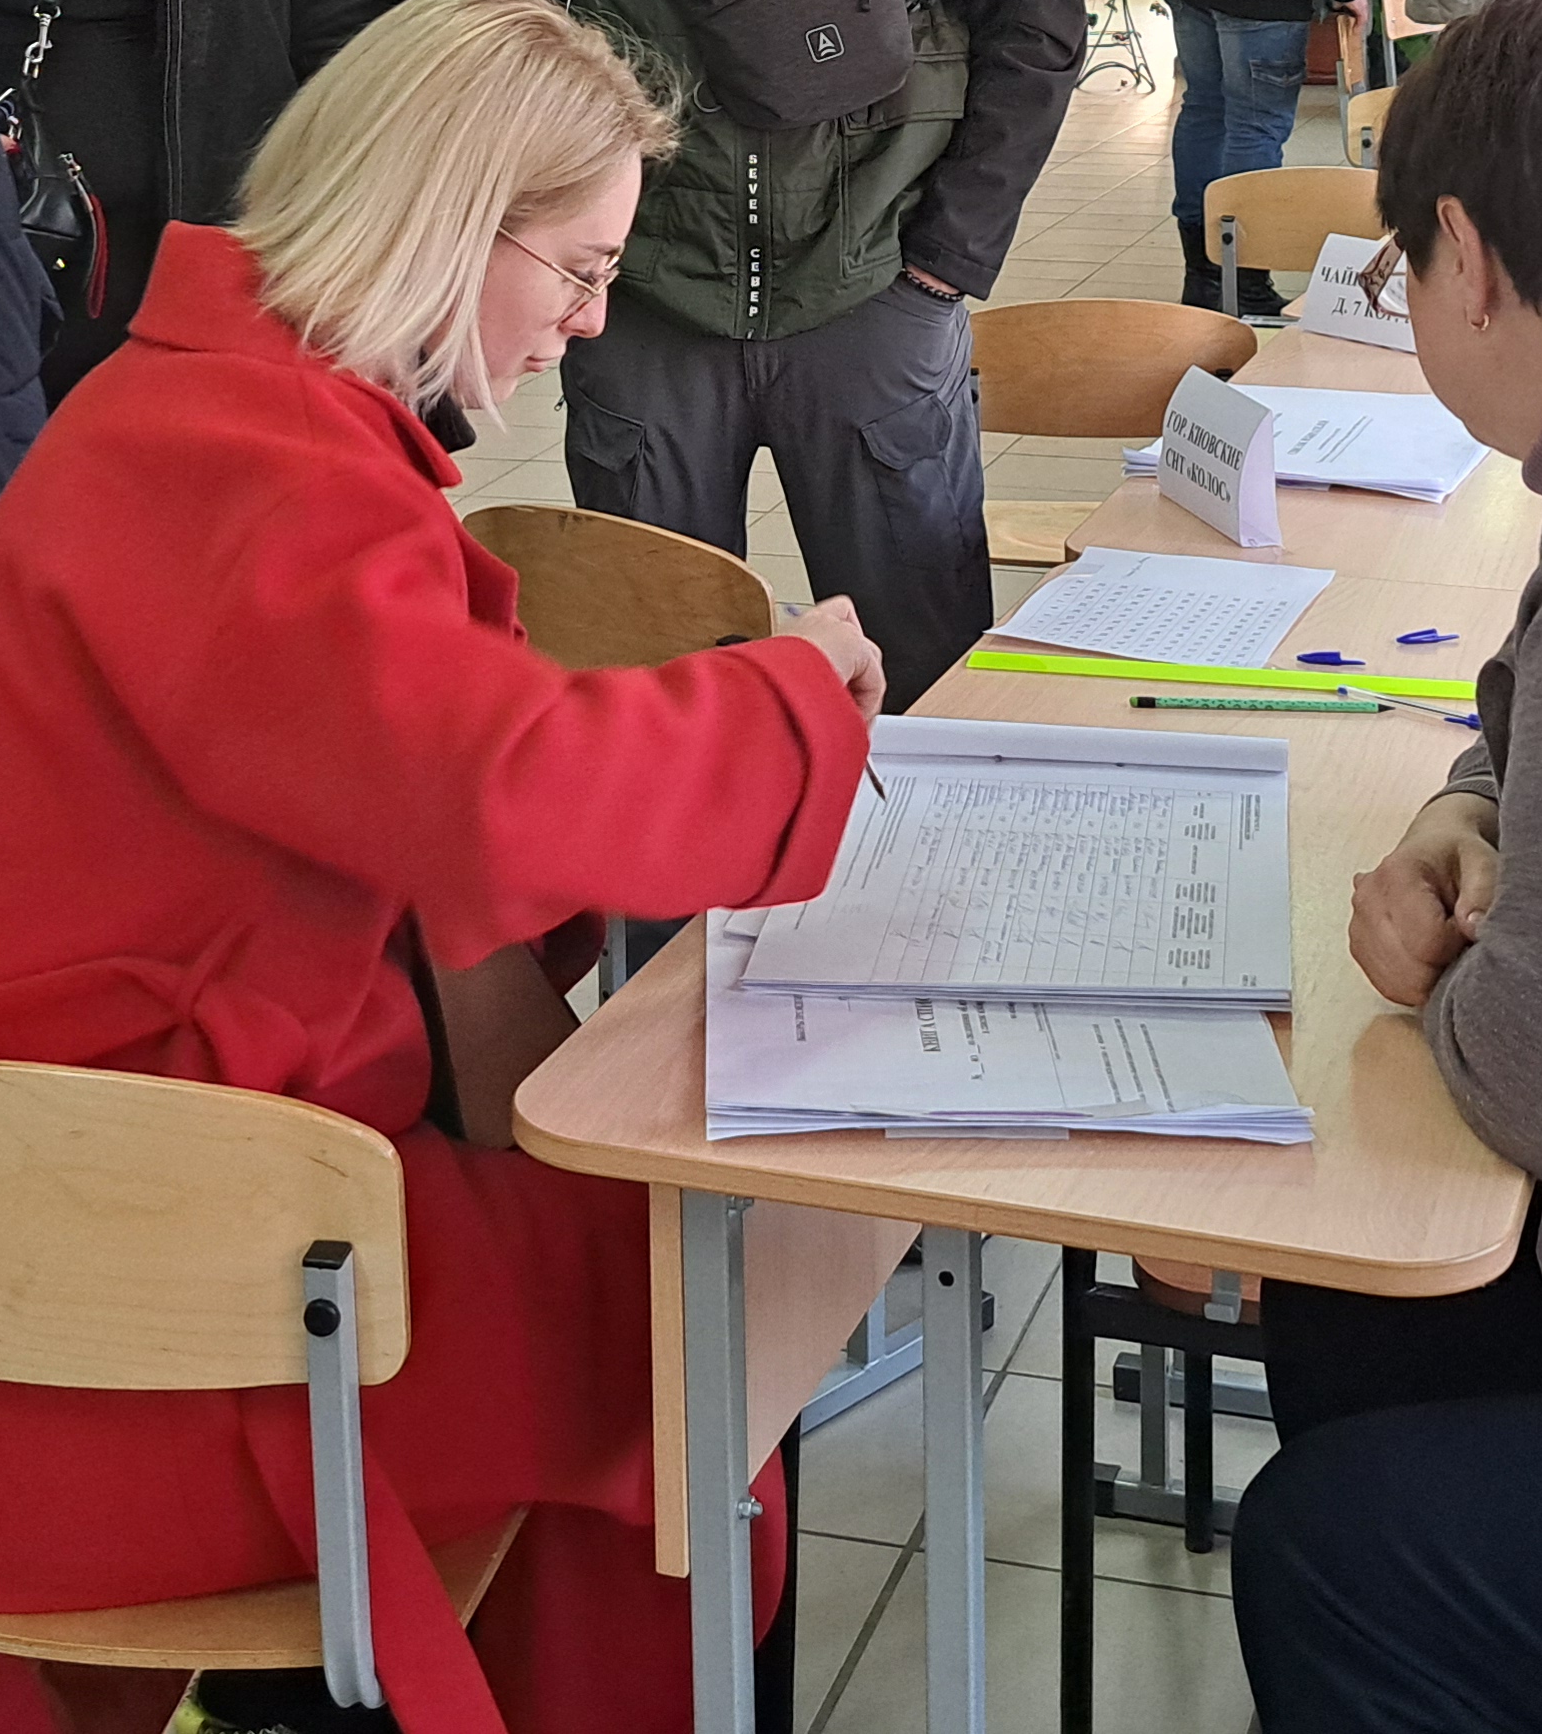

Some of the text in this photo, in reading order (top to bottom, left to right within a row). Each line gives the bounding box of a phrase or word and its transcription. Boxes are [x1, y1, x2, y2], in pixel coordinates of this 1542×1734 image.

[748, 154, 758, 224] SEVER
[1331, 297, 1347, 316] Д.
[1353, 300, 1362, 317] 7
[1166, 410, 1188, 438] ГОР.
[1165, 447, 1186, 475] СНТ
